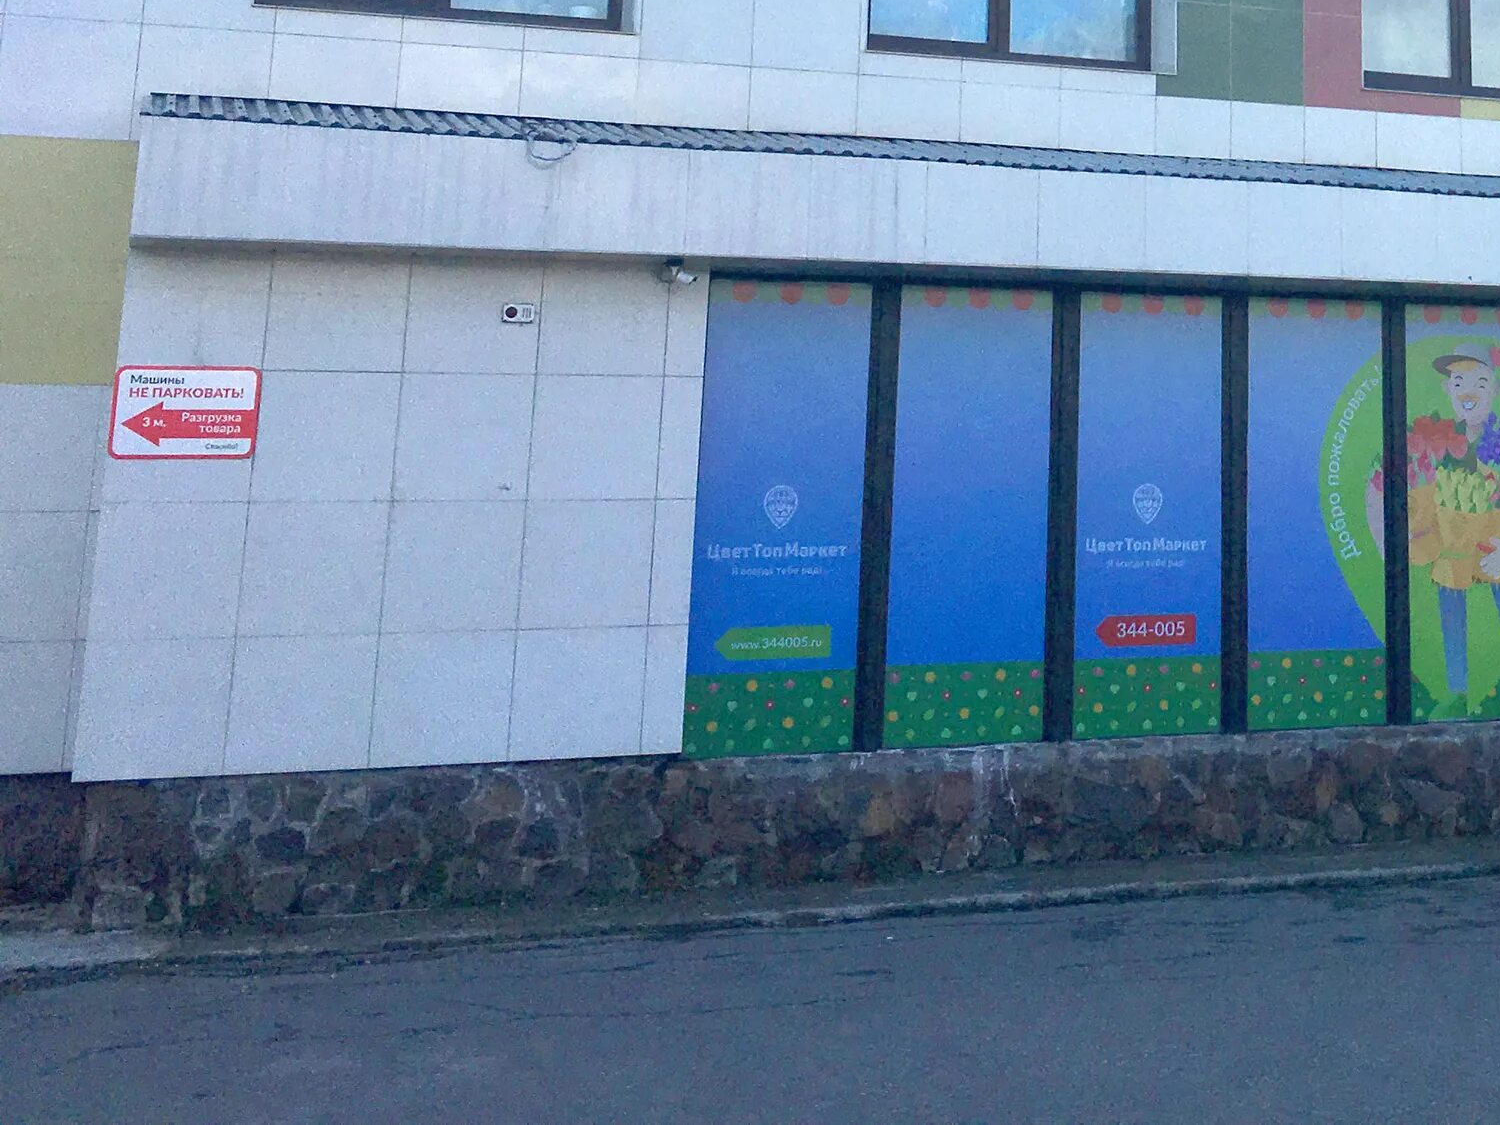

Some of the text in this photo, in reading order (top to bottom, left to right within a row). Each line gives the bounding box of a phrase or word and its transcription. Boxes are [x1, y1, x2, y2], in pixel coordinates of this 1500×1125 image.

[130, 374, 185, 385] Машины
[129, 387, 245, 399] НЕ ПАРКОВАТЬ!
[142, 417, 167, 428] 3 м.
[181, 412, 242, 424] Разгрузка
[199, 425, 241, 435] товара
[1330, 492, 1362, 560] Добро
[1116, 620, 1186, 638] 344-005
[731, 636, 822, 650] www.344005.ru
